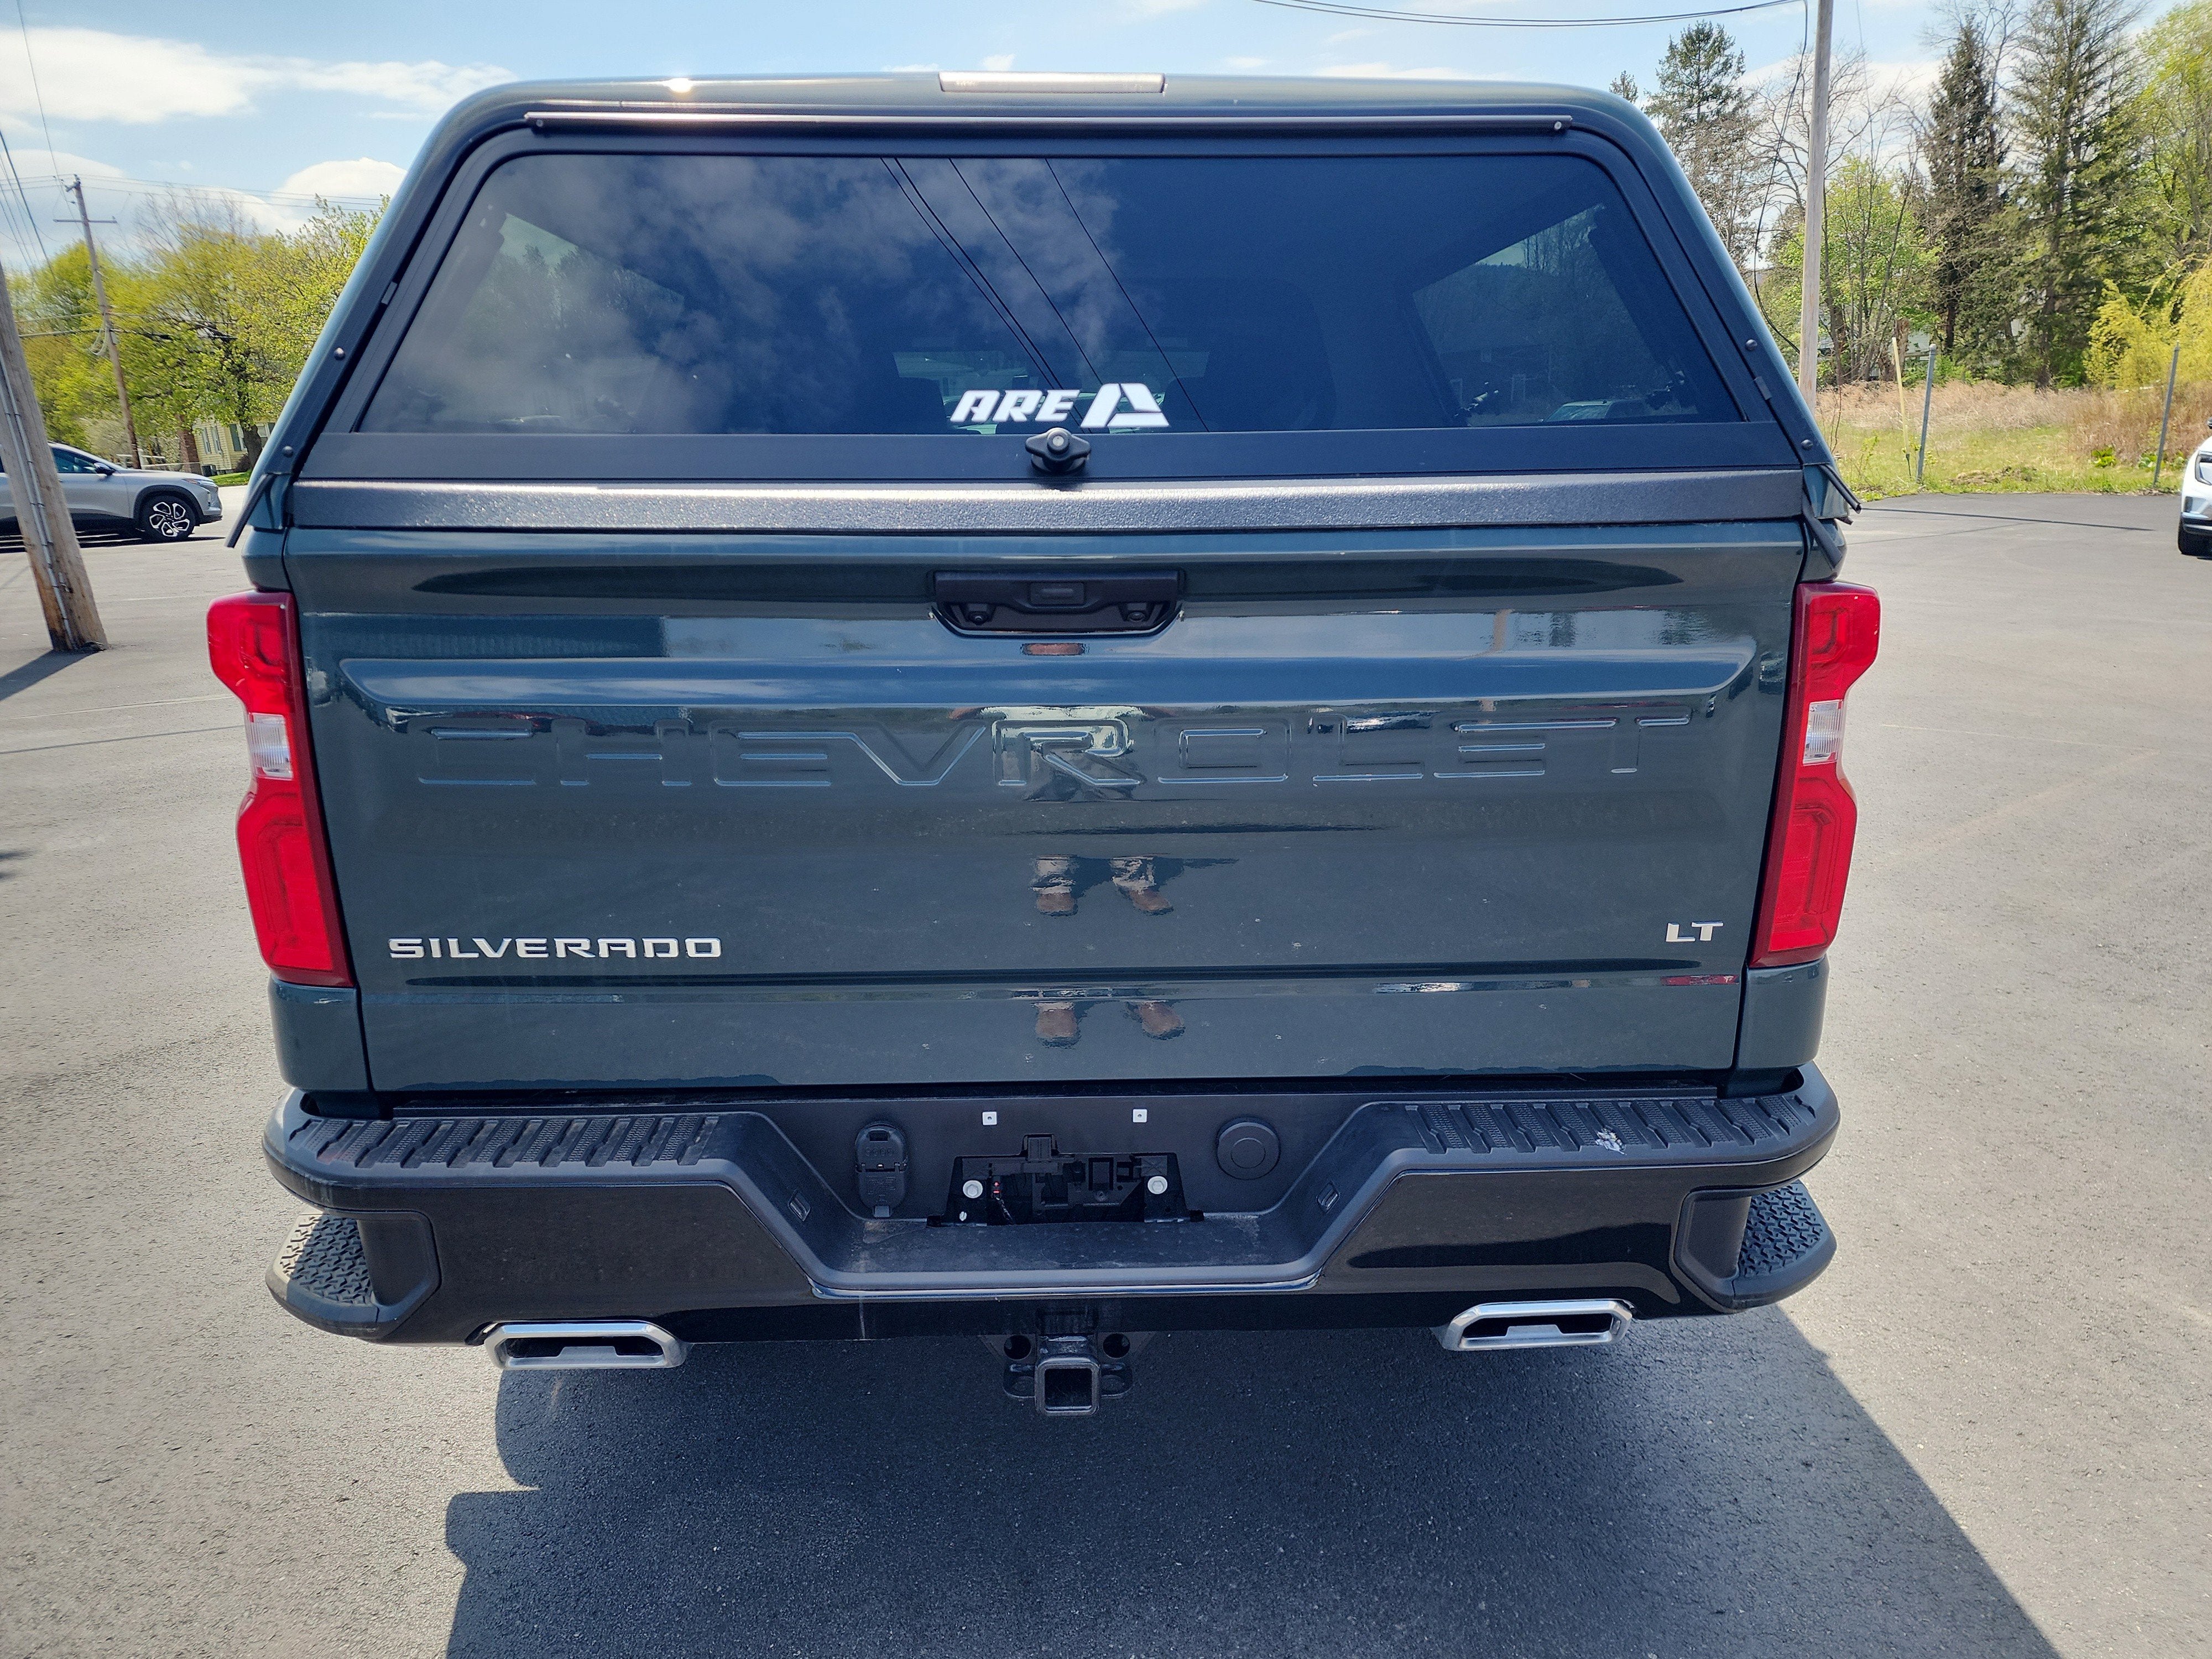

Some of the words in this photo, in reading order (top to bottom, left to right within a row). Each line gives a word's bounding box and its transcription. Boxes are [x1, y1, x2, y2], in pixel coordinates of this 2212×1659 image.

[950, 390, 1081, 422] ARE
[409, 706, 1692, 786] CHEVROLET
[1666, 921, 1724, 942] LT
[389, 938, 722, 958] SILVERADO
